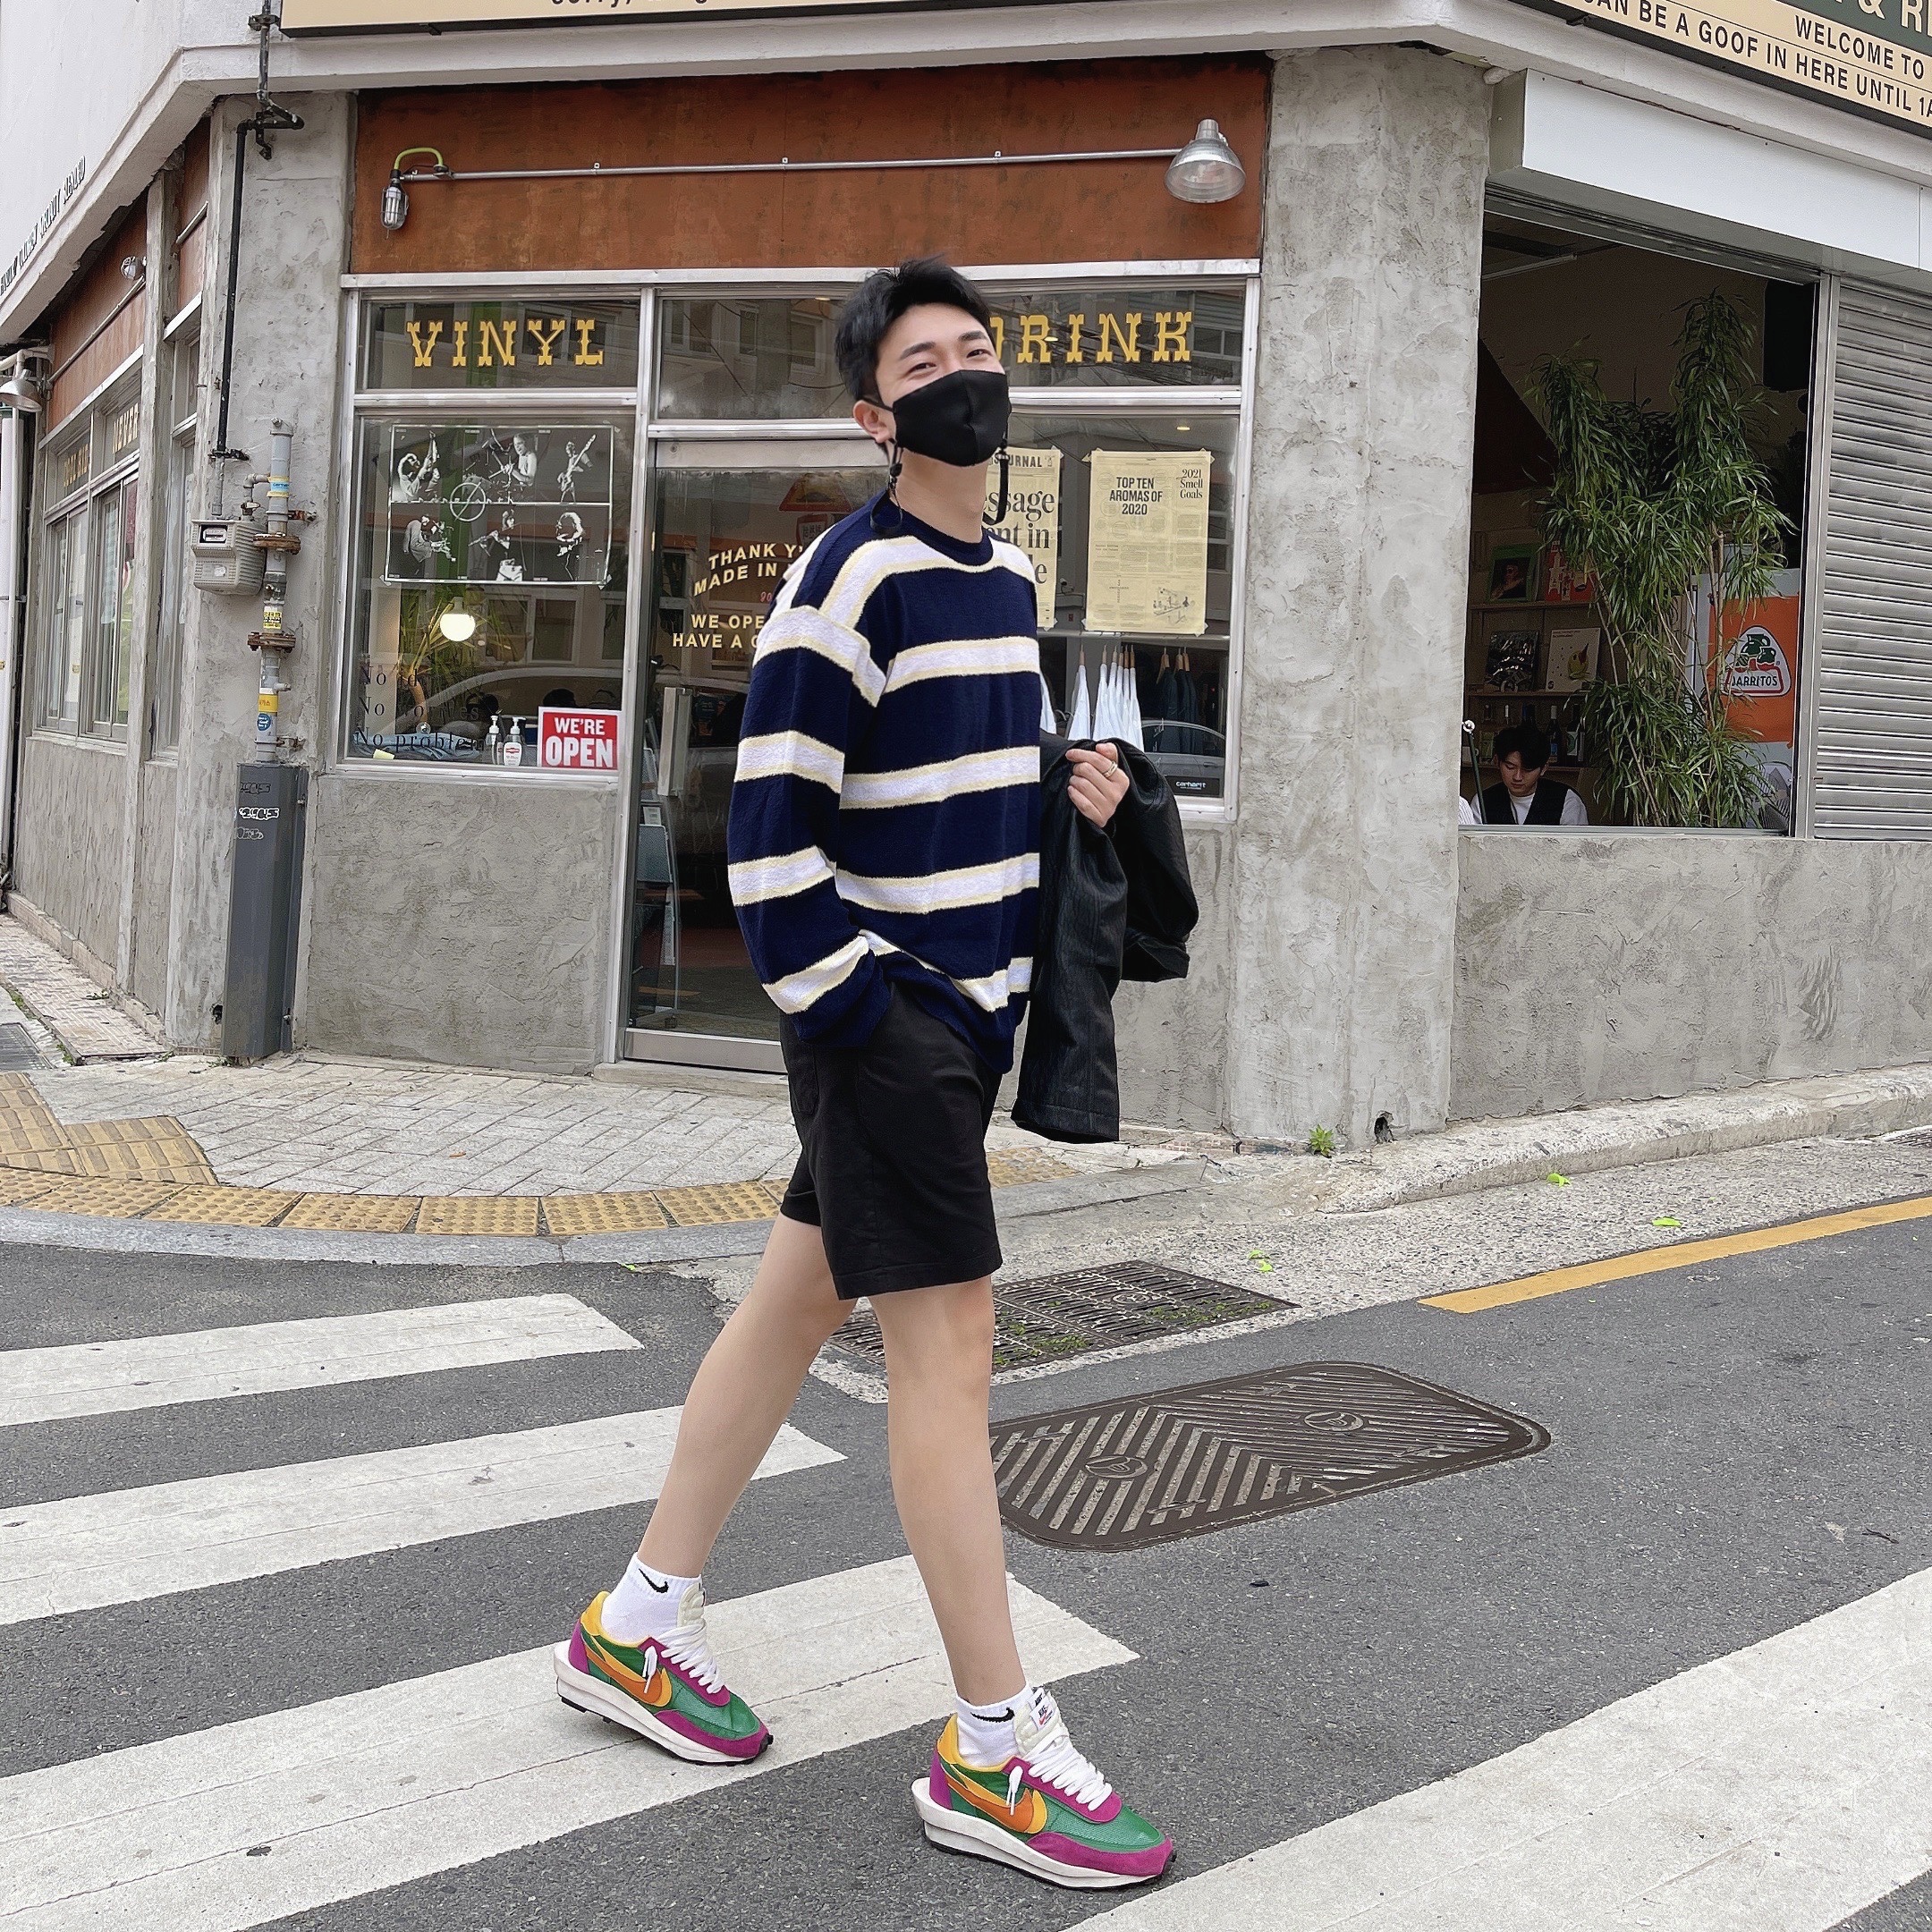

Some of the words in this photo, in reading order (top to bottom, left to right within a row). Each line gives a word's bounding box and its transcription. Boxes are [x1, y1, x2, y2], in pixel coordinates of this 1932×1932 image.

[1639, 0, 1666, 29] BE
[1675, 13, 1690, 37] A
[1699, 20, 1758, 57] GOOF
[1767, 43, 1786, 69] IN
[1796, 53, 1848, 89] HERE
[1856, 73, 1911, 112] UNTIL
[1794, 14, 1894, 70] WELCOME
[1902, 54, 1924, 80] TO
[407, 318, 604, 368] VINYL
[1116, 477, 1135, 489] TOP
[1136, 478, 1155, 489] TEN
[1182, 469, 1202, 479] 2021
[1180, 479, 1203, 488] Smell
[1109, 490, 1149, 502] AROMAS
[1150, 491, 1163, 503] OF
[1180, 489, 1203, 498] Goals
[1122, 504, 1148, 515] 2020
[1028, 523, 1050, 548] in
[708, 543, 776, 571] THANK
[693, 564, 749, 597] MADE
[758, 563, 777, 577] IN
[691, 614, 719, 629] WE
[673, 632, 722, 648] HAVE
[730, 634, 743, 648] A
[1732, 675, 1778, 687] JARRITOS
[359, 696, 385, 716] No
[555, 717, 606, 735] WE'RE
[356, 726, 383, 746] No
[545, 735, 614, 767] OPEN
